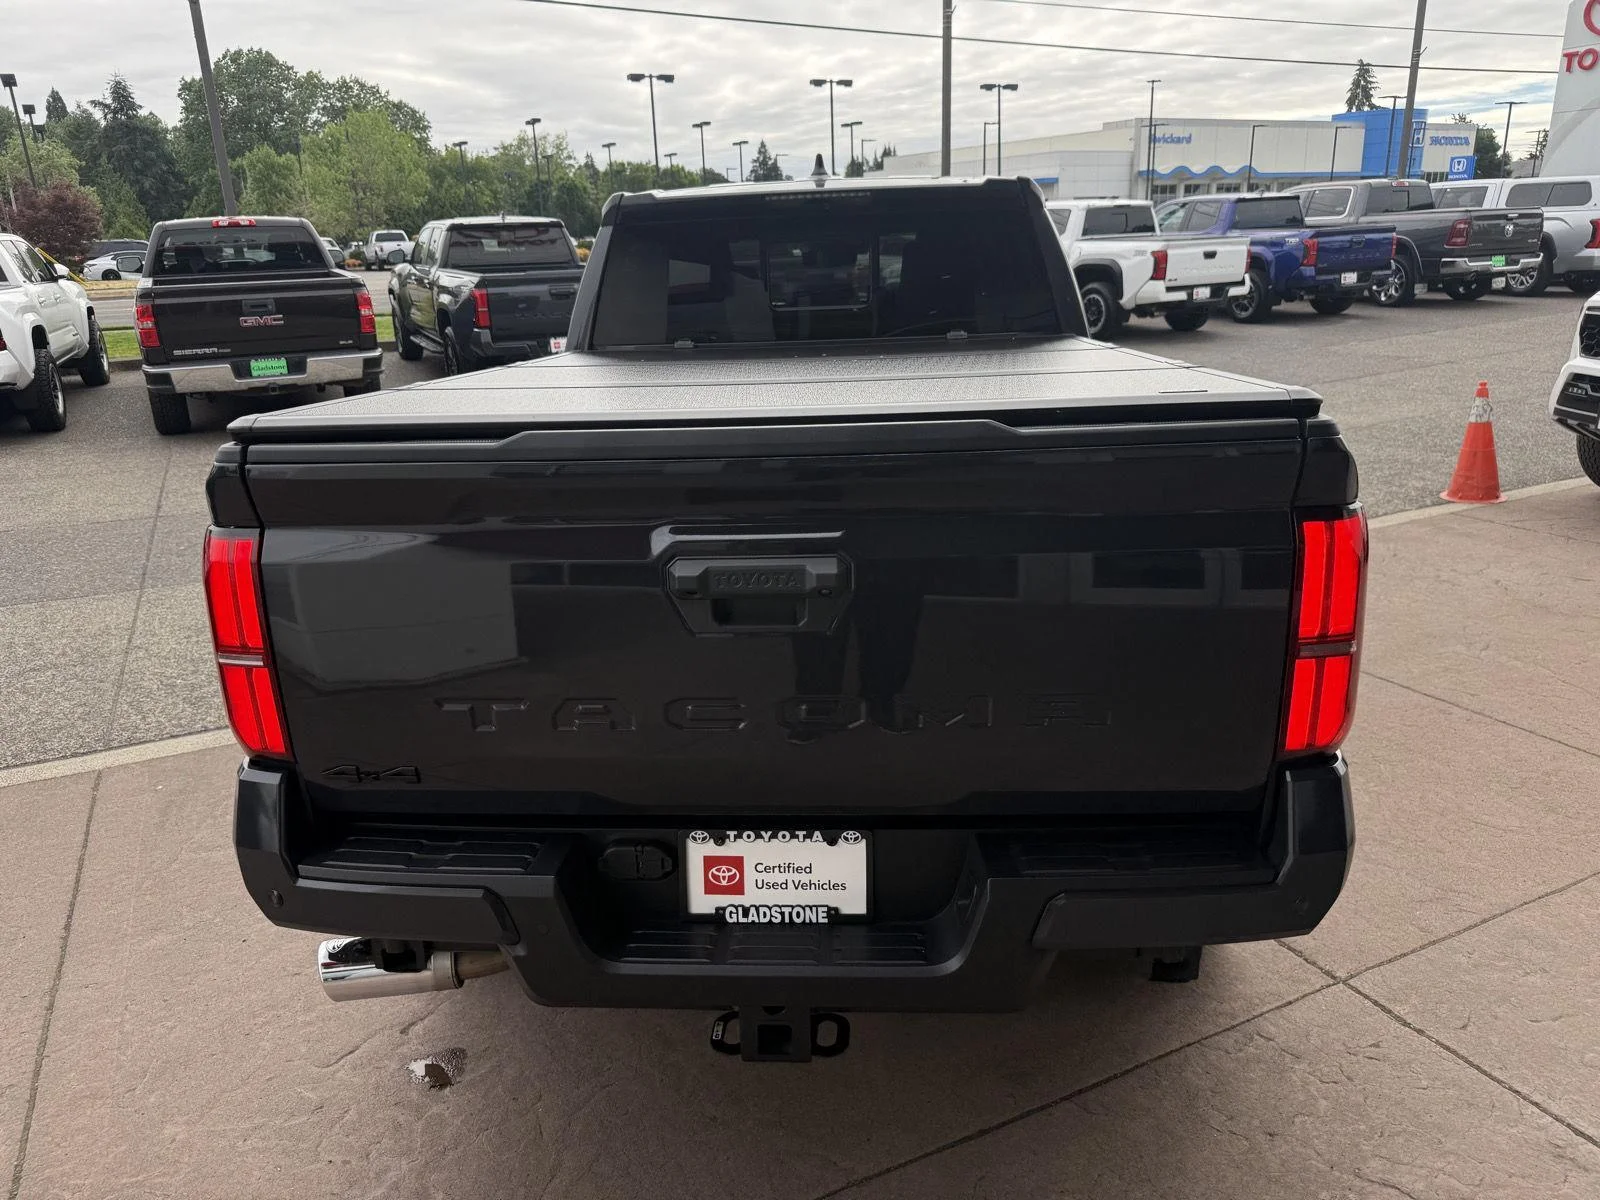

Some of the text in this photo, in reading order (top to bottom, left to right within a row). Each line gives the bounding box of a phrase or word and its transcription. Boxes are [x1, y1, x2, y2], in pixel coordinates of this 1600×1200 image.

[1429, 136, 1470, 145] HONDA
[239, 315, 284, 327] GMC
[252, 364, 286, 372] Gladstone
[714, 571, 800, 588] TOYOTA
[434, 696, 1112, 732] TACOMA
[726, 831, 824, 843] TOYOTA
[754, 862, 813, 875] Certified
[755, 879, 847, 891] Used Vehicles
[725, 906, 829, 924] GLADSTONE
